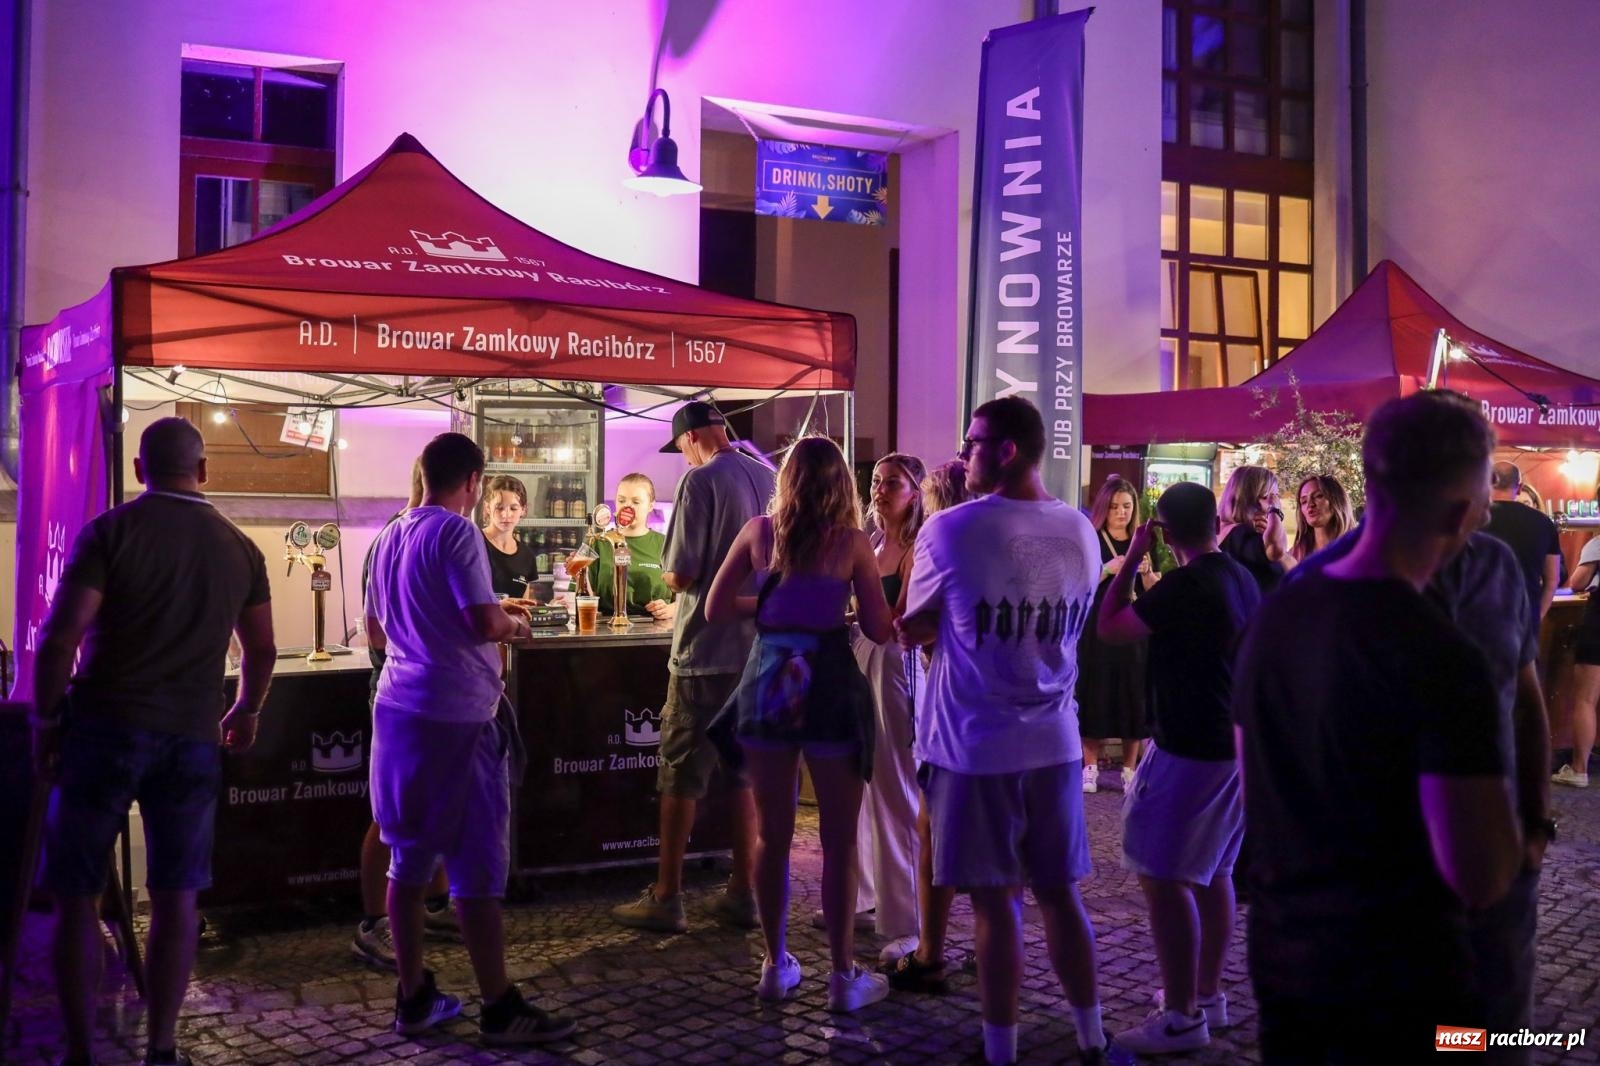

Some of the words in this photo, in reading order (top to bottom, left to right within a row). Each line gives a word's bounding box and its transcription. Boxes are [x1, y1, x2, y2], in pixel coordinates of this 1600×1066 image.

[388, 246, 418, 256] A.D.
[513, 256, 546, 267] 1567
[282, 254, 393, 271] Browar
[400, 259, 540, 282] Zamkowy
[546, 271, 673, 295] Racibórz
[1056, 231, 1073, 346] BROWARZE
[299, 320, 337, 346] A.D.
[377, 322, 454, 349] Browar
[462, 326, 560, 360] Zamkowy
[567, 331, 656, 360] Racibórz
[685, 339, 726, 364] 1567
[1054, 357, 1074, 411] PRZY
[1482, 399, 1534, 425] Browar
[1053, 420, 1073, 460] PUB
[553, 755, 606, 775] Browar
[228, 782, 287, 805] Browar
[293, 779, 369, 800] Zamkowy
[602, 835, 661, 851] www.racibo
